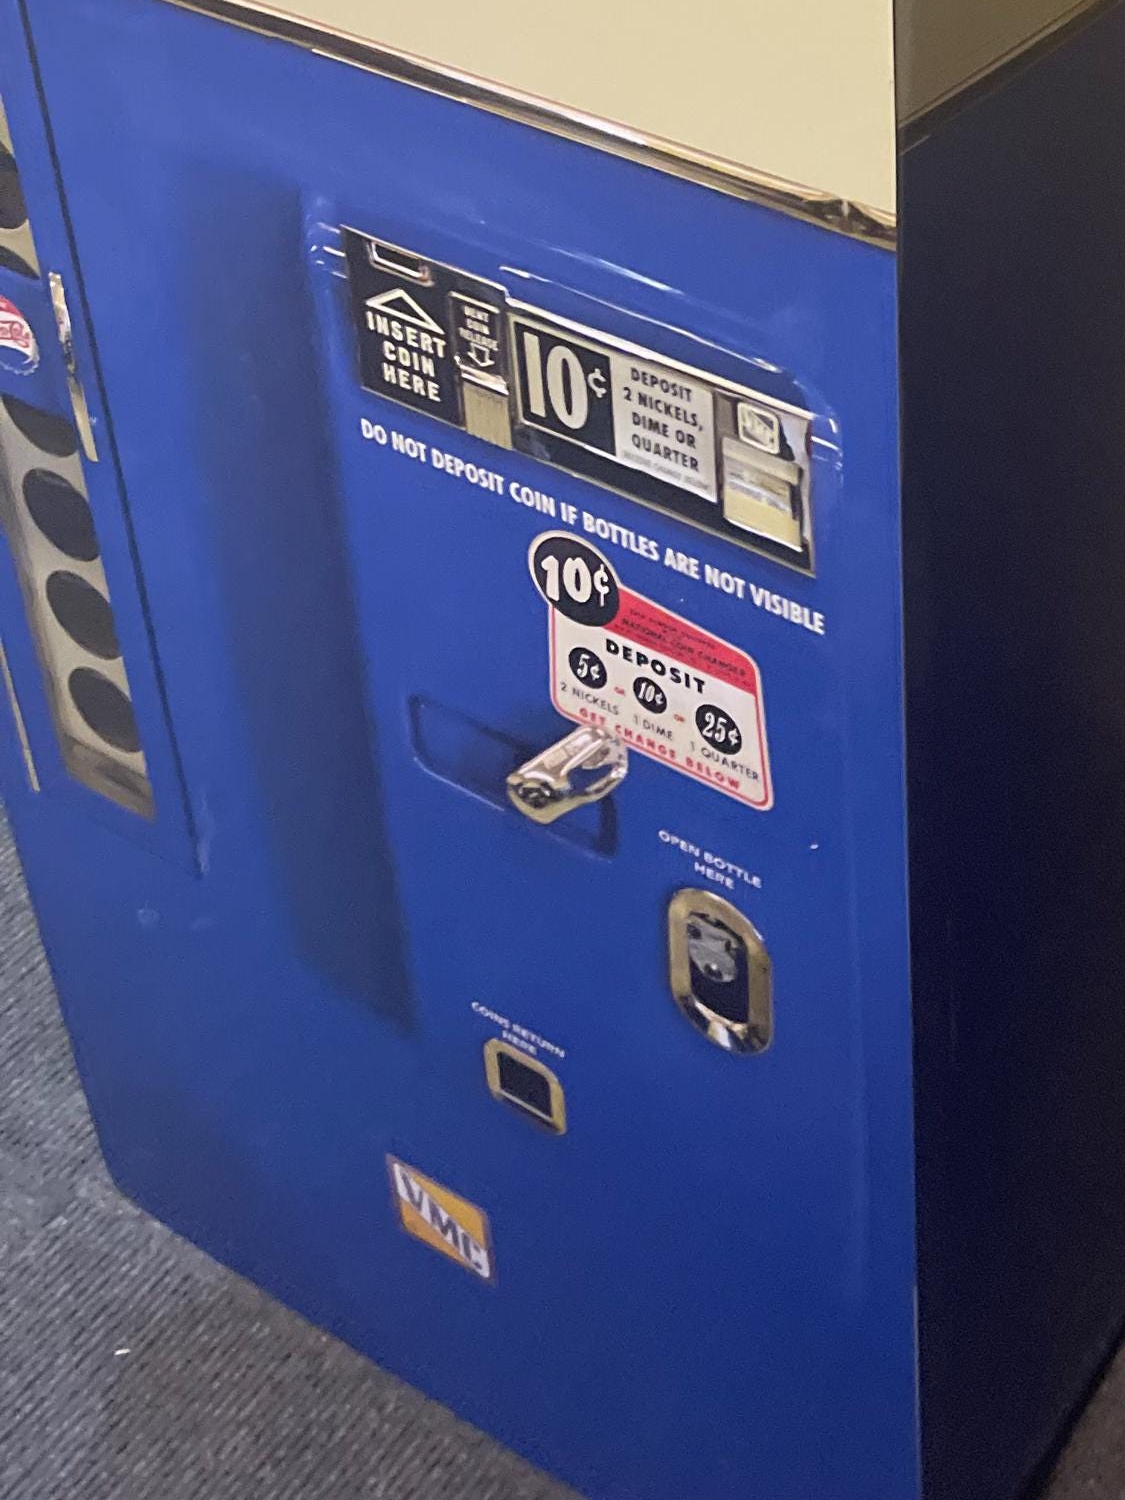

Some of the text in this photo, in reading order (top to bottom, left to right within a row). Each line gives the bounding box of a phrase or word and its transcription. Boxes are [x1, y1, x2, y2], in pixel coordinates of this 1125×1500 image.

[365, 311, 447, 358] INSERT
[383, 340, 435, 377] COIN
[382, 362, 441, 402] HERE
[523, 331, 608, 430] 10¢
[623, 386, 633, 401] 2
[630, 367, 693, 401] DEPOSIT
[631, 434, 700, 473] QUARTER
[632, 412, 698, 450] DIME OR
[360, 418, 387, 442] DO
[391, 431, 428, 465] NOT
[430, 448, 505, 496] DEPOSIT
[509, 481, 556, 518] COIN
[559, 501, 579, 526] IF
[582, 511, 660, 562] BOTTLES
[663, 546, 702, 581] ARE
[704, 563, 746, 600] NOT
[749, 582, 827, 636] VISIBLE
[540, 554, 611, 608] 10¢
[605, 638, 707, 695] DEPOSIT
[576, 653, 601, 681] 5¢
[638, 681, 664, 705] 10¢
[702, 712, 740, 747] 25¢
[560, 681, 568, 692] 2
[572, 687, 620, 716] NICKELS
[643, 719, 674, 741] DIME
[700, 746, 760, 781] QUARTER
[579, 707, 740, 790] GET CHANGE BELOW
[658, 829, 762, 889] OPEN BOTTLE
[694, 861, 735, 890] HERE
